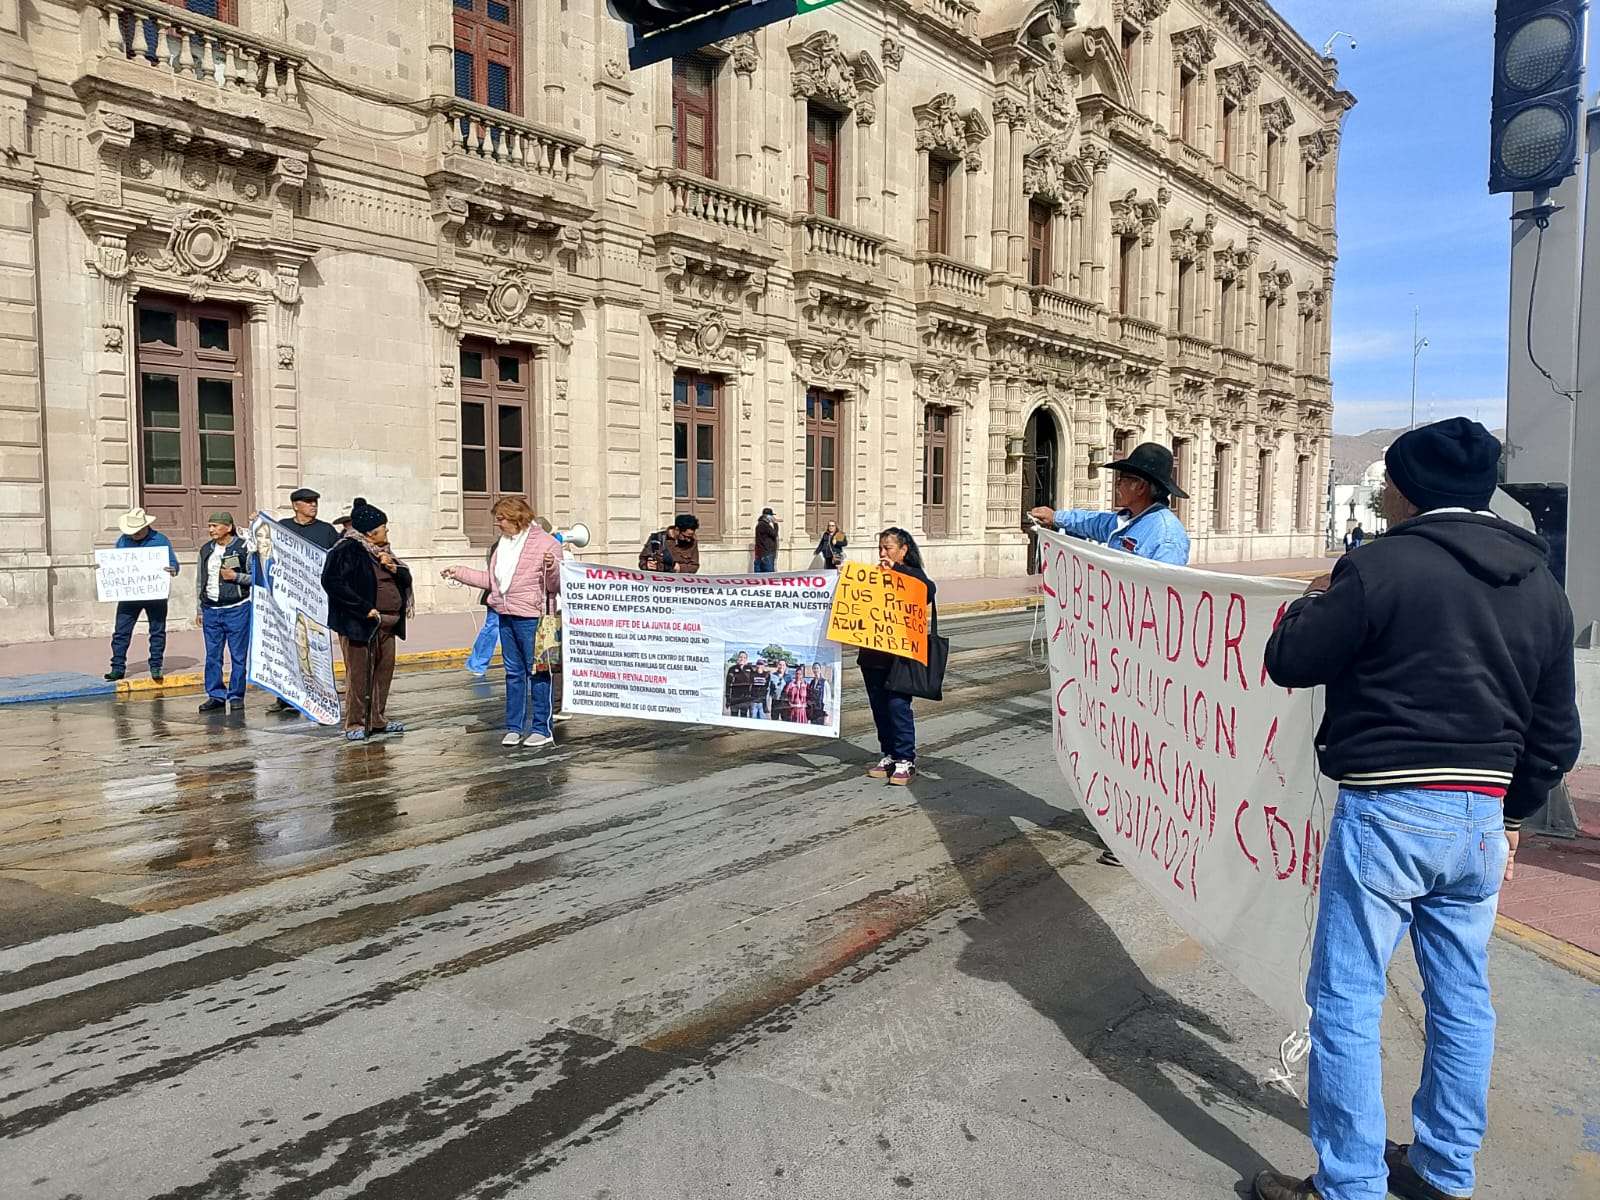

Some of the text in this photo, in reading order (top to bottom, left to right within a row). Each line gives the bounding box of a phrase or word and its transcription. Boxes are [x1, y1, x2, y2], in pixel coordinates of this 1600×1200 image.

[270, 566, 282, 578] NO
[586, 568, 644, 581] MARU
[716, 576, 826, 588] GOBIERNO
[844, 564, 906, 591] LOERA
[652, 585, 672, 593] NOS
[675, 586, 714, 595] PISOTEA
[740, 589, 771, 597] CLASE
[774, 590, 799, 598] BAJA
[841, 584, 872, 602] TUS
[586, 593, 650, 602] LADRILLEROS
[652, 596, 727, 606] QUERIENDONOS
[730, 600, 789, 608] ARREBATAR
[567, 603, 674, 614] TERRENO EMPESANDO:
[836, 602, 861, 616] DE
[585, 618, 613, 626] FALOMIR
[616, 620, 630, 628] JEFE
[642, 621, 649, 629] LA
[651, 621, 671, 630] JUNTA
[673, 623, 681, 631] DE
[683, 623, 701, 632] AGUA
[832, 616, 893, 635] AZUL NO
[848, 633, 919, 653] SIRBEN
[589, 670, 616, 679] FALOMIR
[623, 673, 643, 681] REYNA
[645, 675, 667, 684] DURAN
[680, 688, 699, 696] CENTRO
[1081, 632, 1099, 687] YA
[1111, 648, 1237, 759] SOLUCION
[1256, 716, 1286, 787] A
[1056, 678, 1216, 843] COMENDACION
